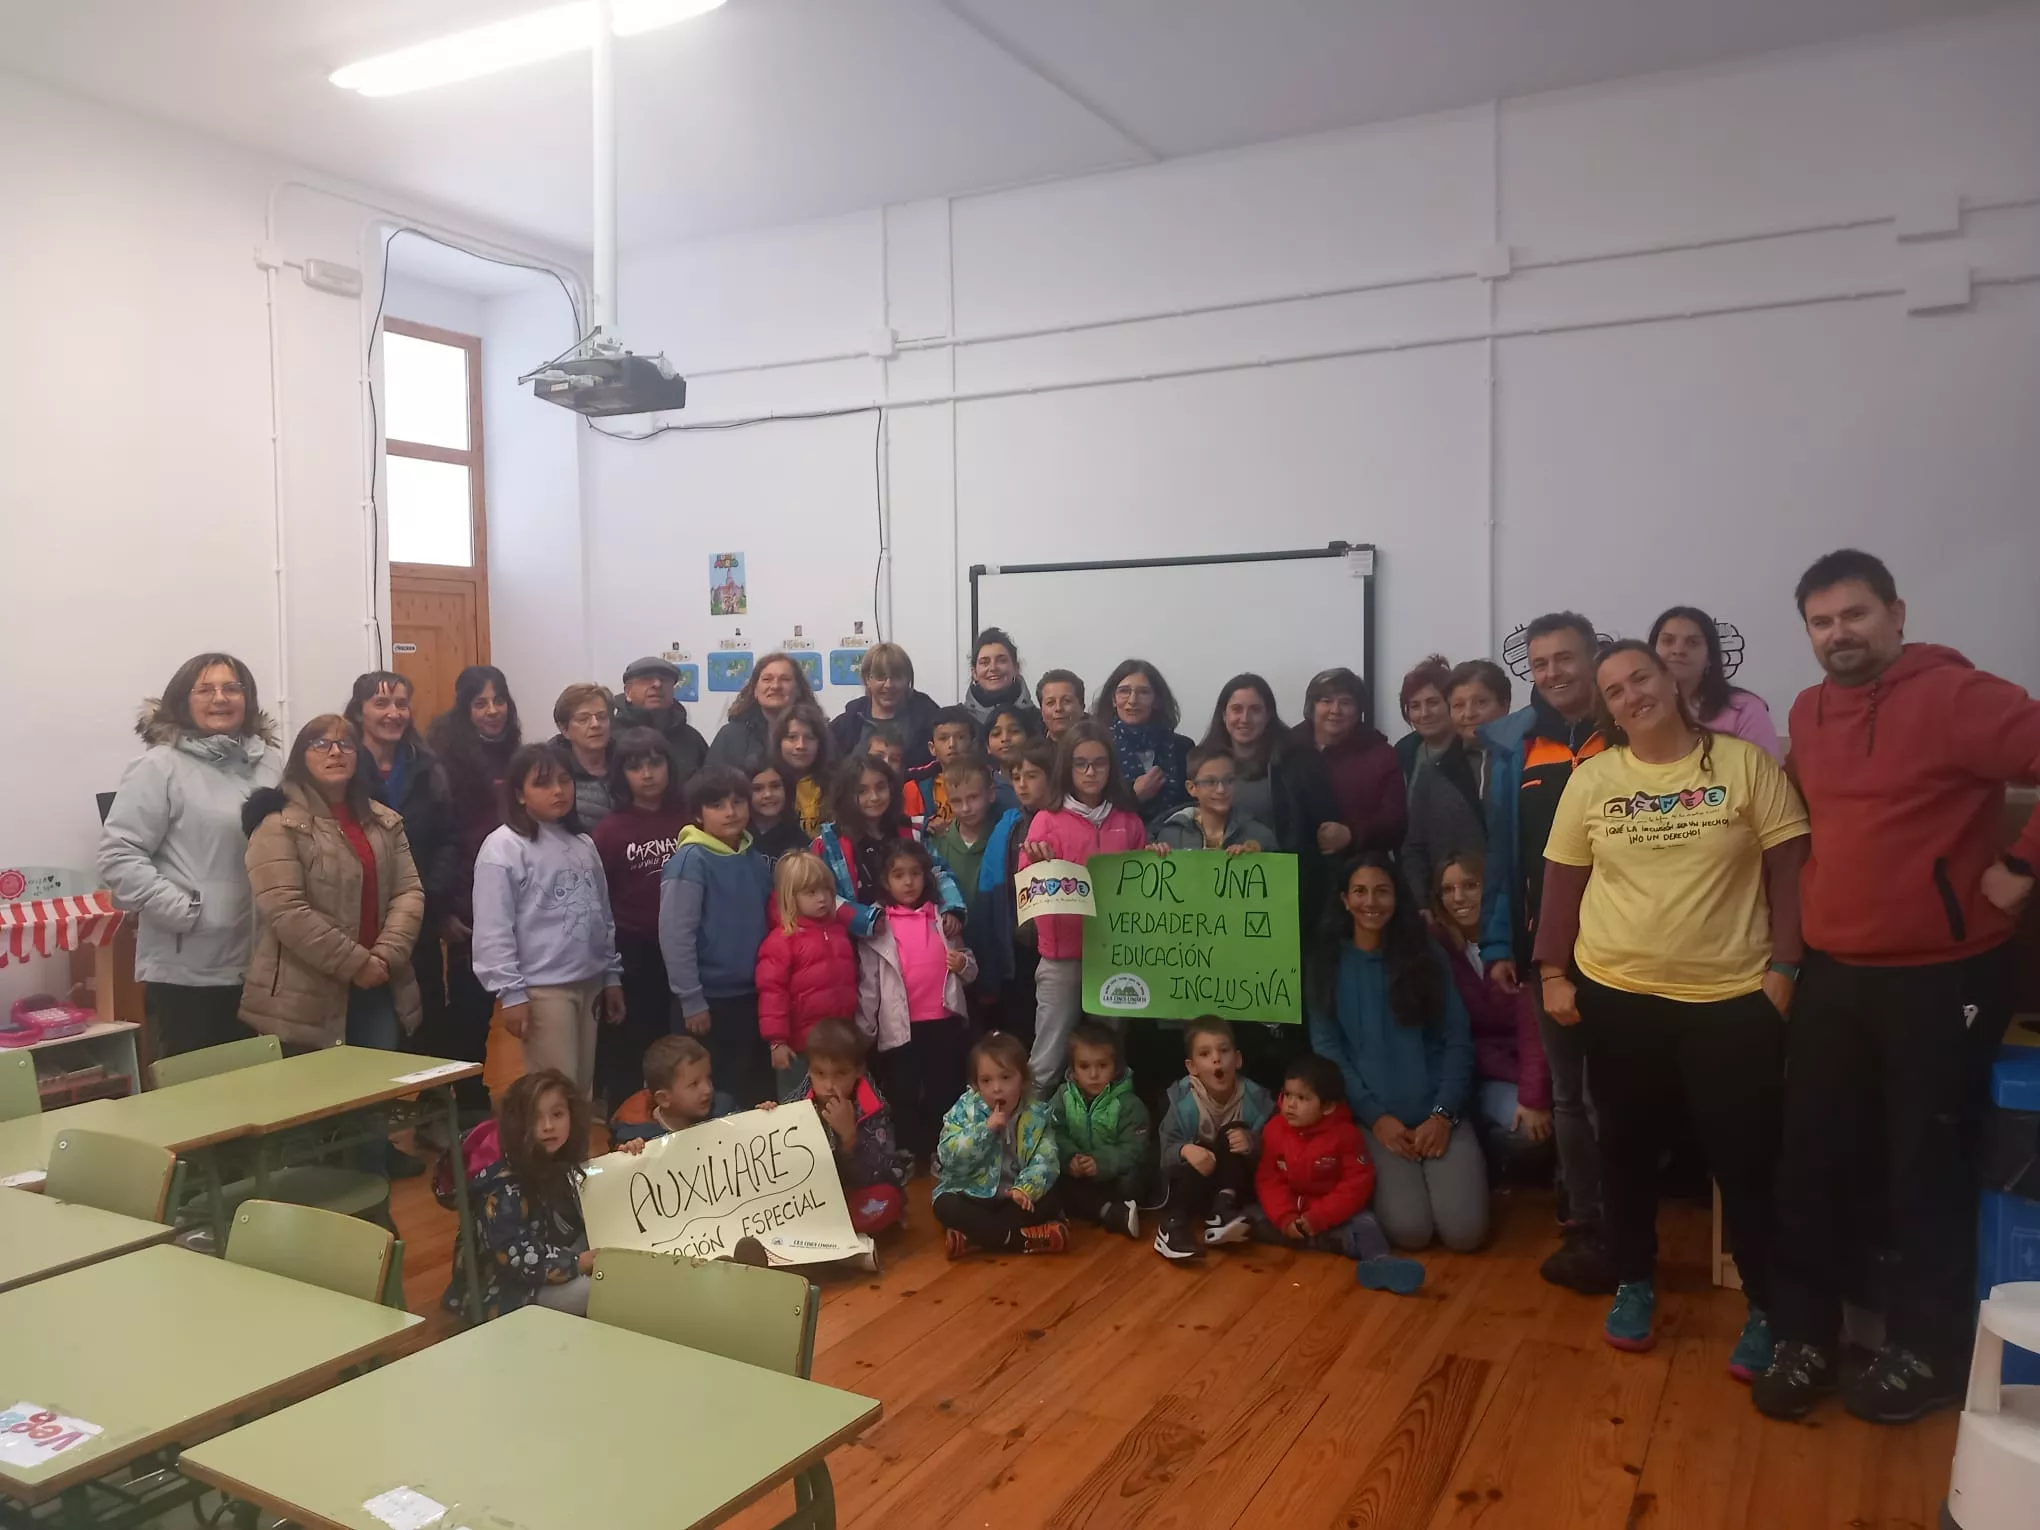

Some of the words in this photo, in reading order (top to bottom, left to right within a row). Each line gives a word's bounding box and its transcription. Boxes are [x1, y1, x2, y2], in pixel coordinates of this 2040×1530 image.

[1626, 824, 1638, 833] LA
[1646, 833, 1660, 842] UN
[1116, 859, 1185, 904] POR
[1214, 857, 1269, 900] UNA
[1108, 911, 1227, 937] VERDADERA
